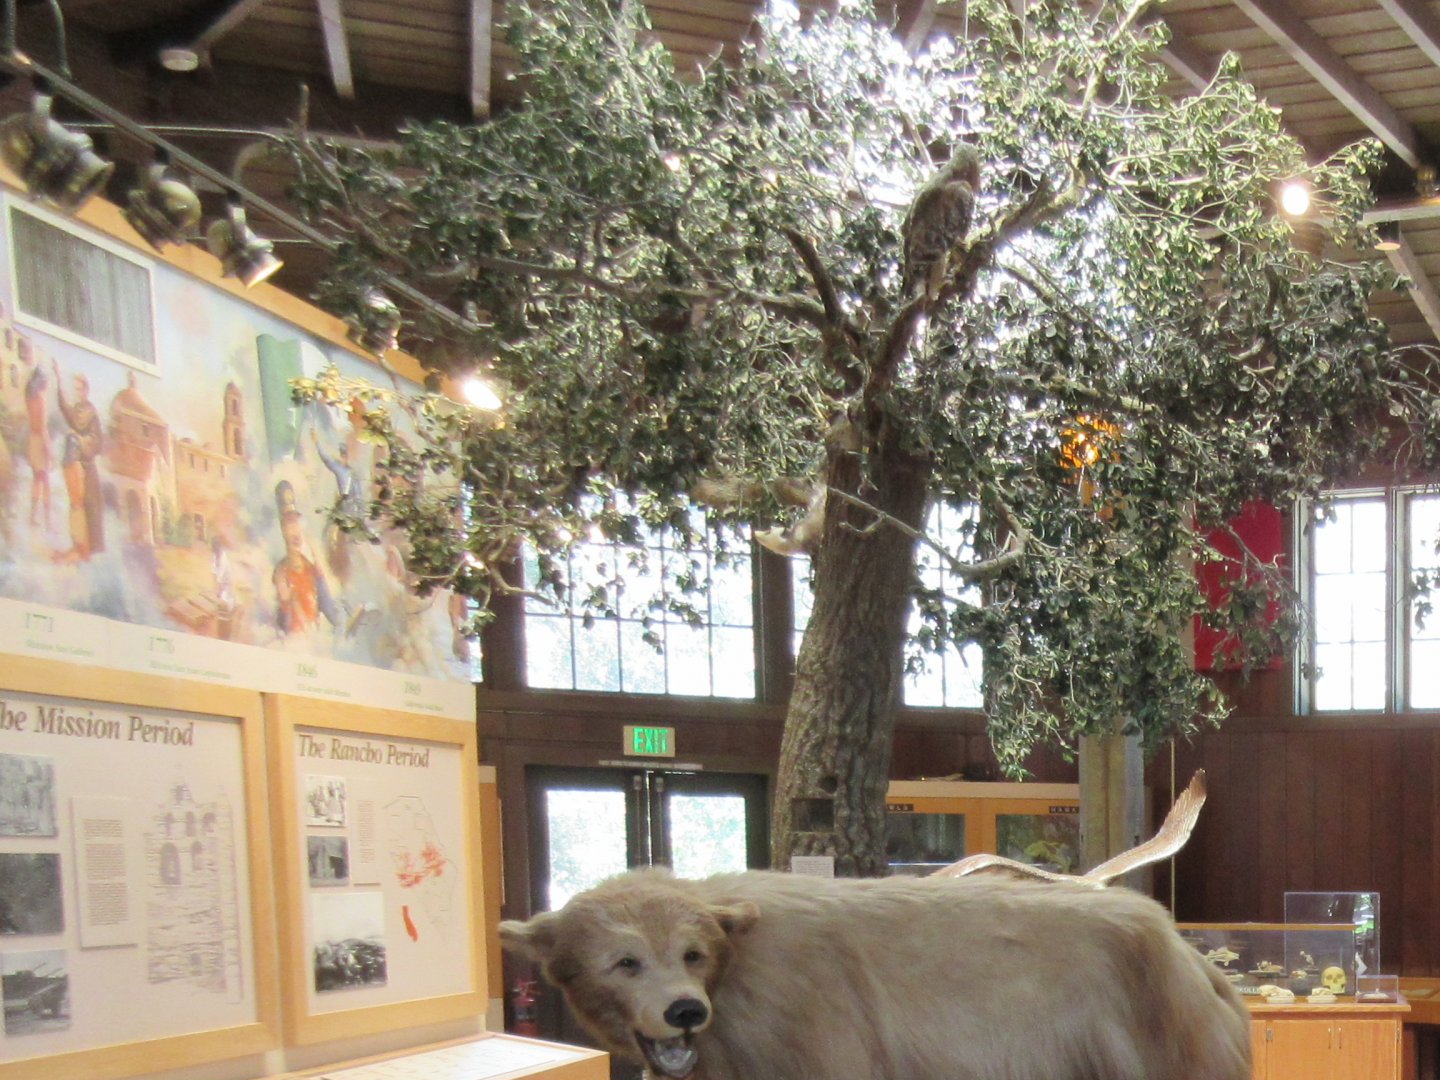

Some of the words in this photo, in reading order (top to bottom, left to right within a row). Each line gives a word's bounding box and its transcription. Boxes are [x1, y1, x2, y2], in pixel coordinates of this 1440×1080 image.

[0, 701, 27, 731] he
[34, 705, 121, 740] Mission
[128, 715, 194, 746] Period
[633, 727, 668, 754] EXIT
[299, 734, 326, 758] The
[330, 738, 383, 764] Rancho
[386, 744, 430, 768] Period
